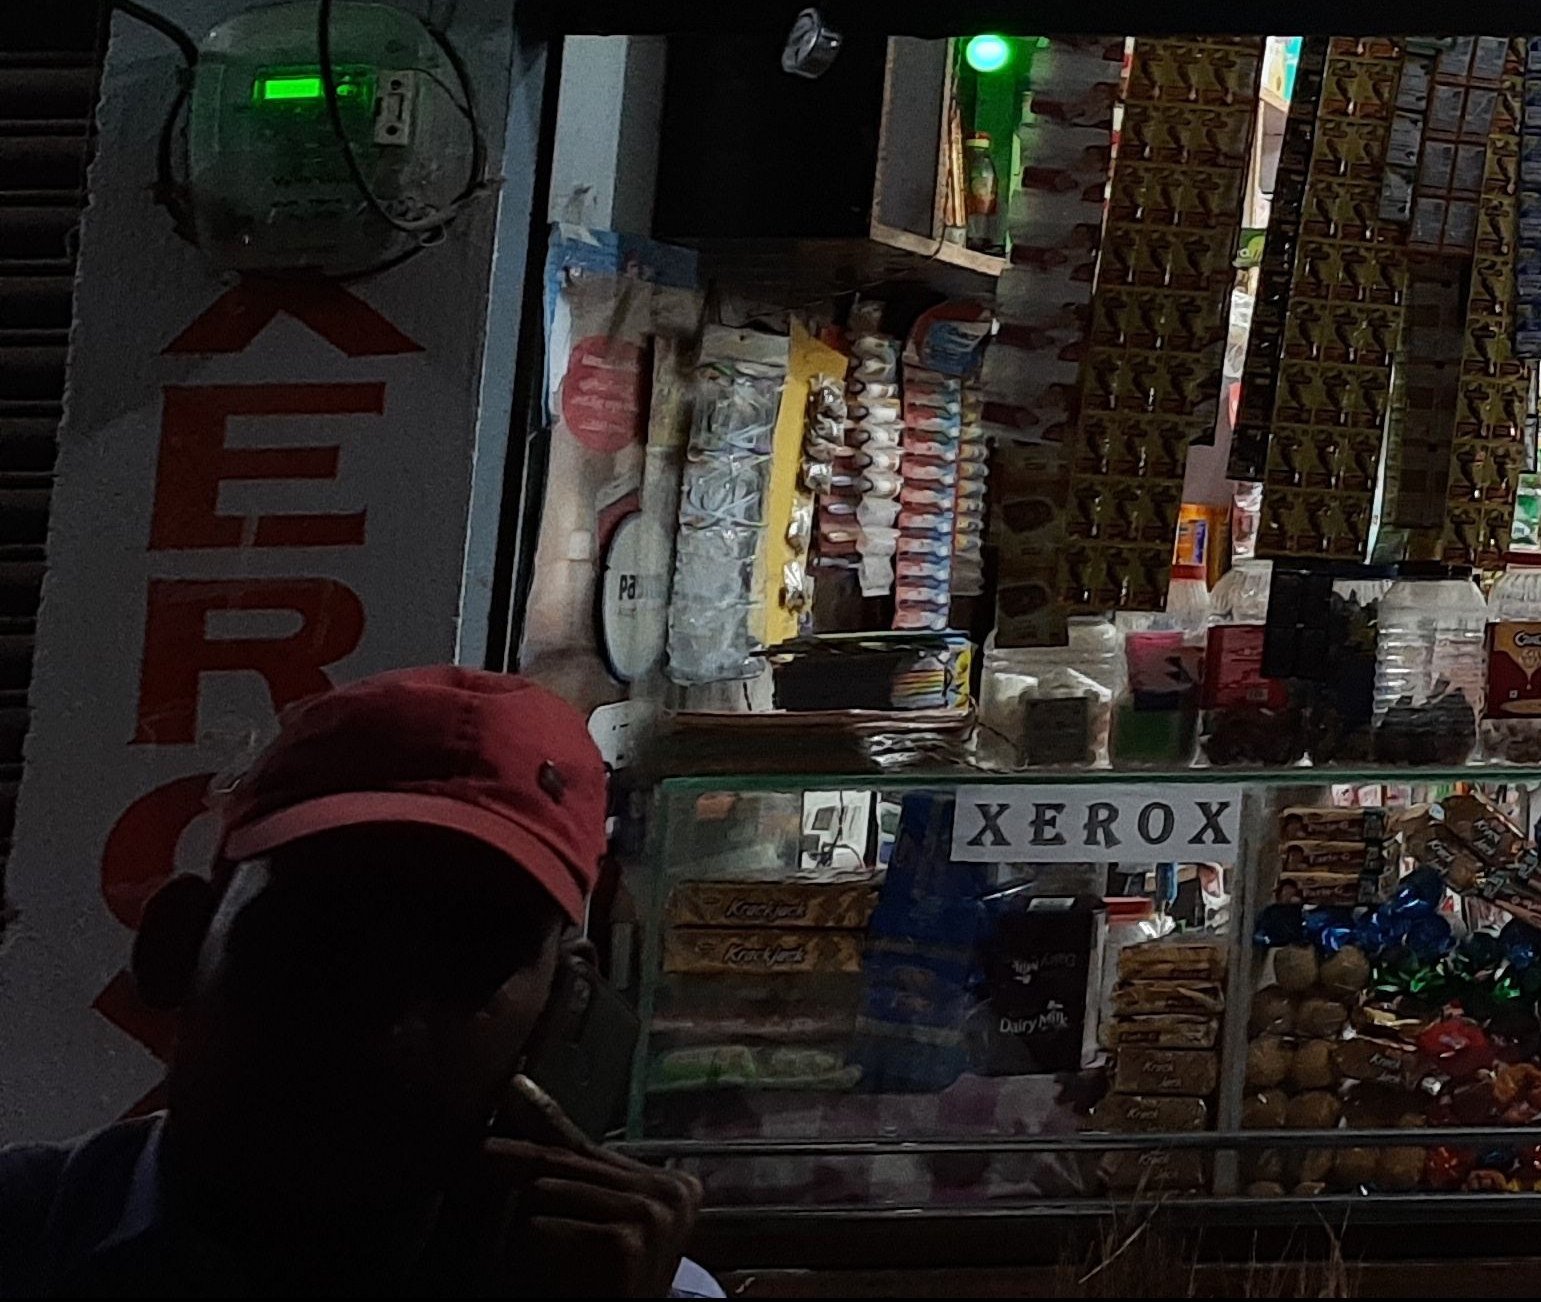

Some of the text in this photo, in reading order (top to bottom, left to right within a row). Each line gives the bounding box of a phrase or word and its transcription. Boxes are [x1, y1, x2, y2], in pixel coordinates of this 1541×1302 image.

[966, 801, 1232, 848] XEROX
[1000, 1009, 1070, 1035] Dairy Milk
